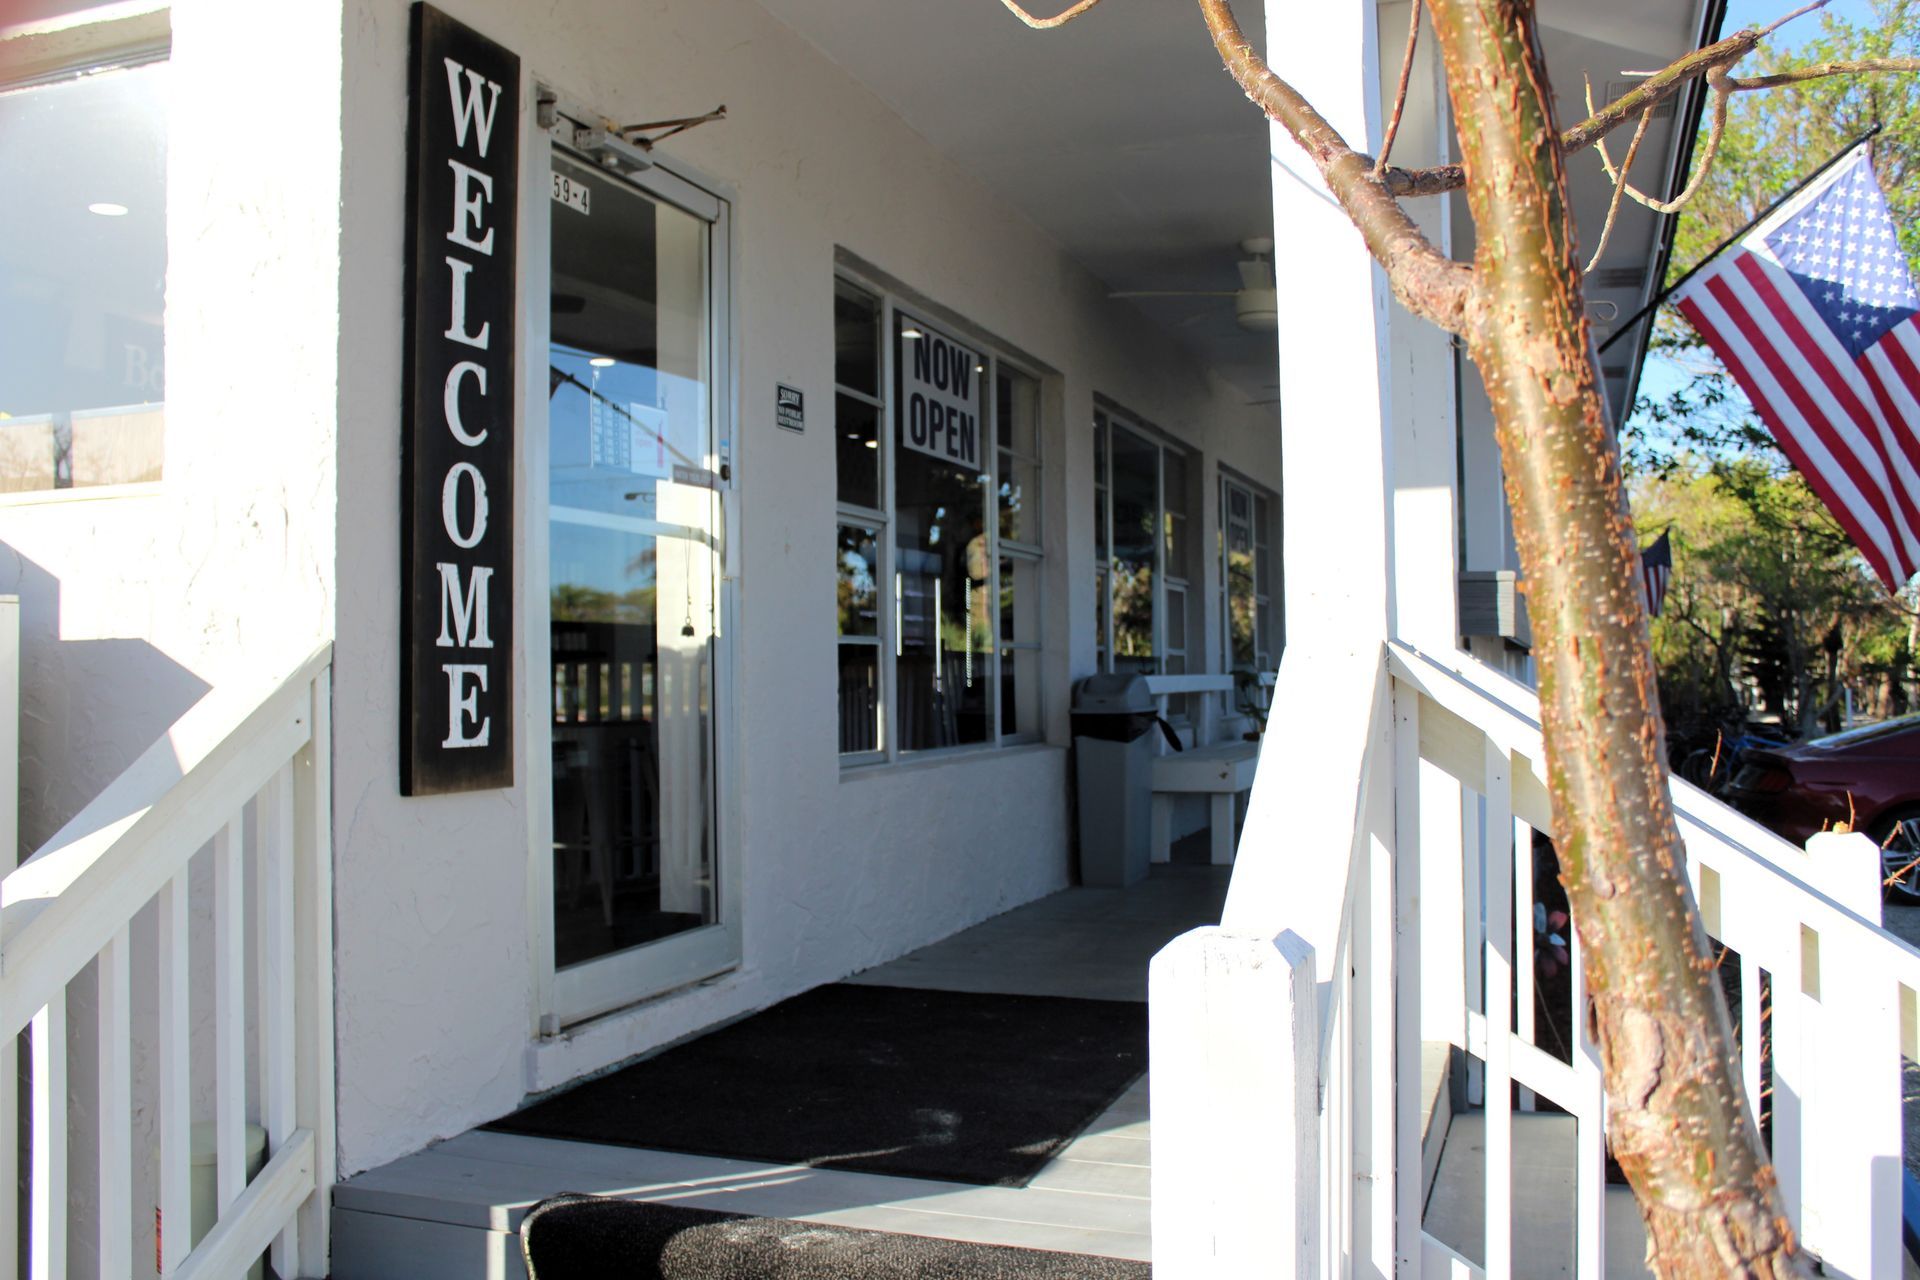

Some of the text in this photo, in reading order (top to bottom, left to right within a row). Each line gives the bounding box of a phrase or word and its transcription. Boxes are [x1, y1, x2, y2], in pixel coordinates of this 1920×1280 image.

[553, 174, 588, 213] 59-4
[780, 389, 800, 406] SORRY
[914, 328, 970, 401] NOW
[436, 57, 503, 749] WELCOME
[910, 392, 974, 463] OPEN
